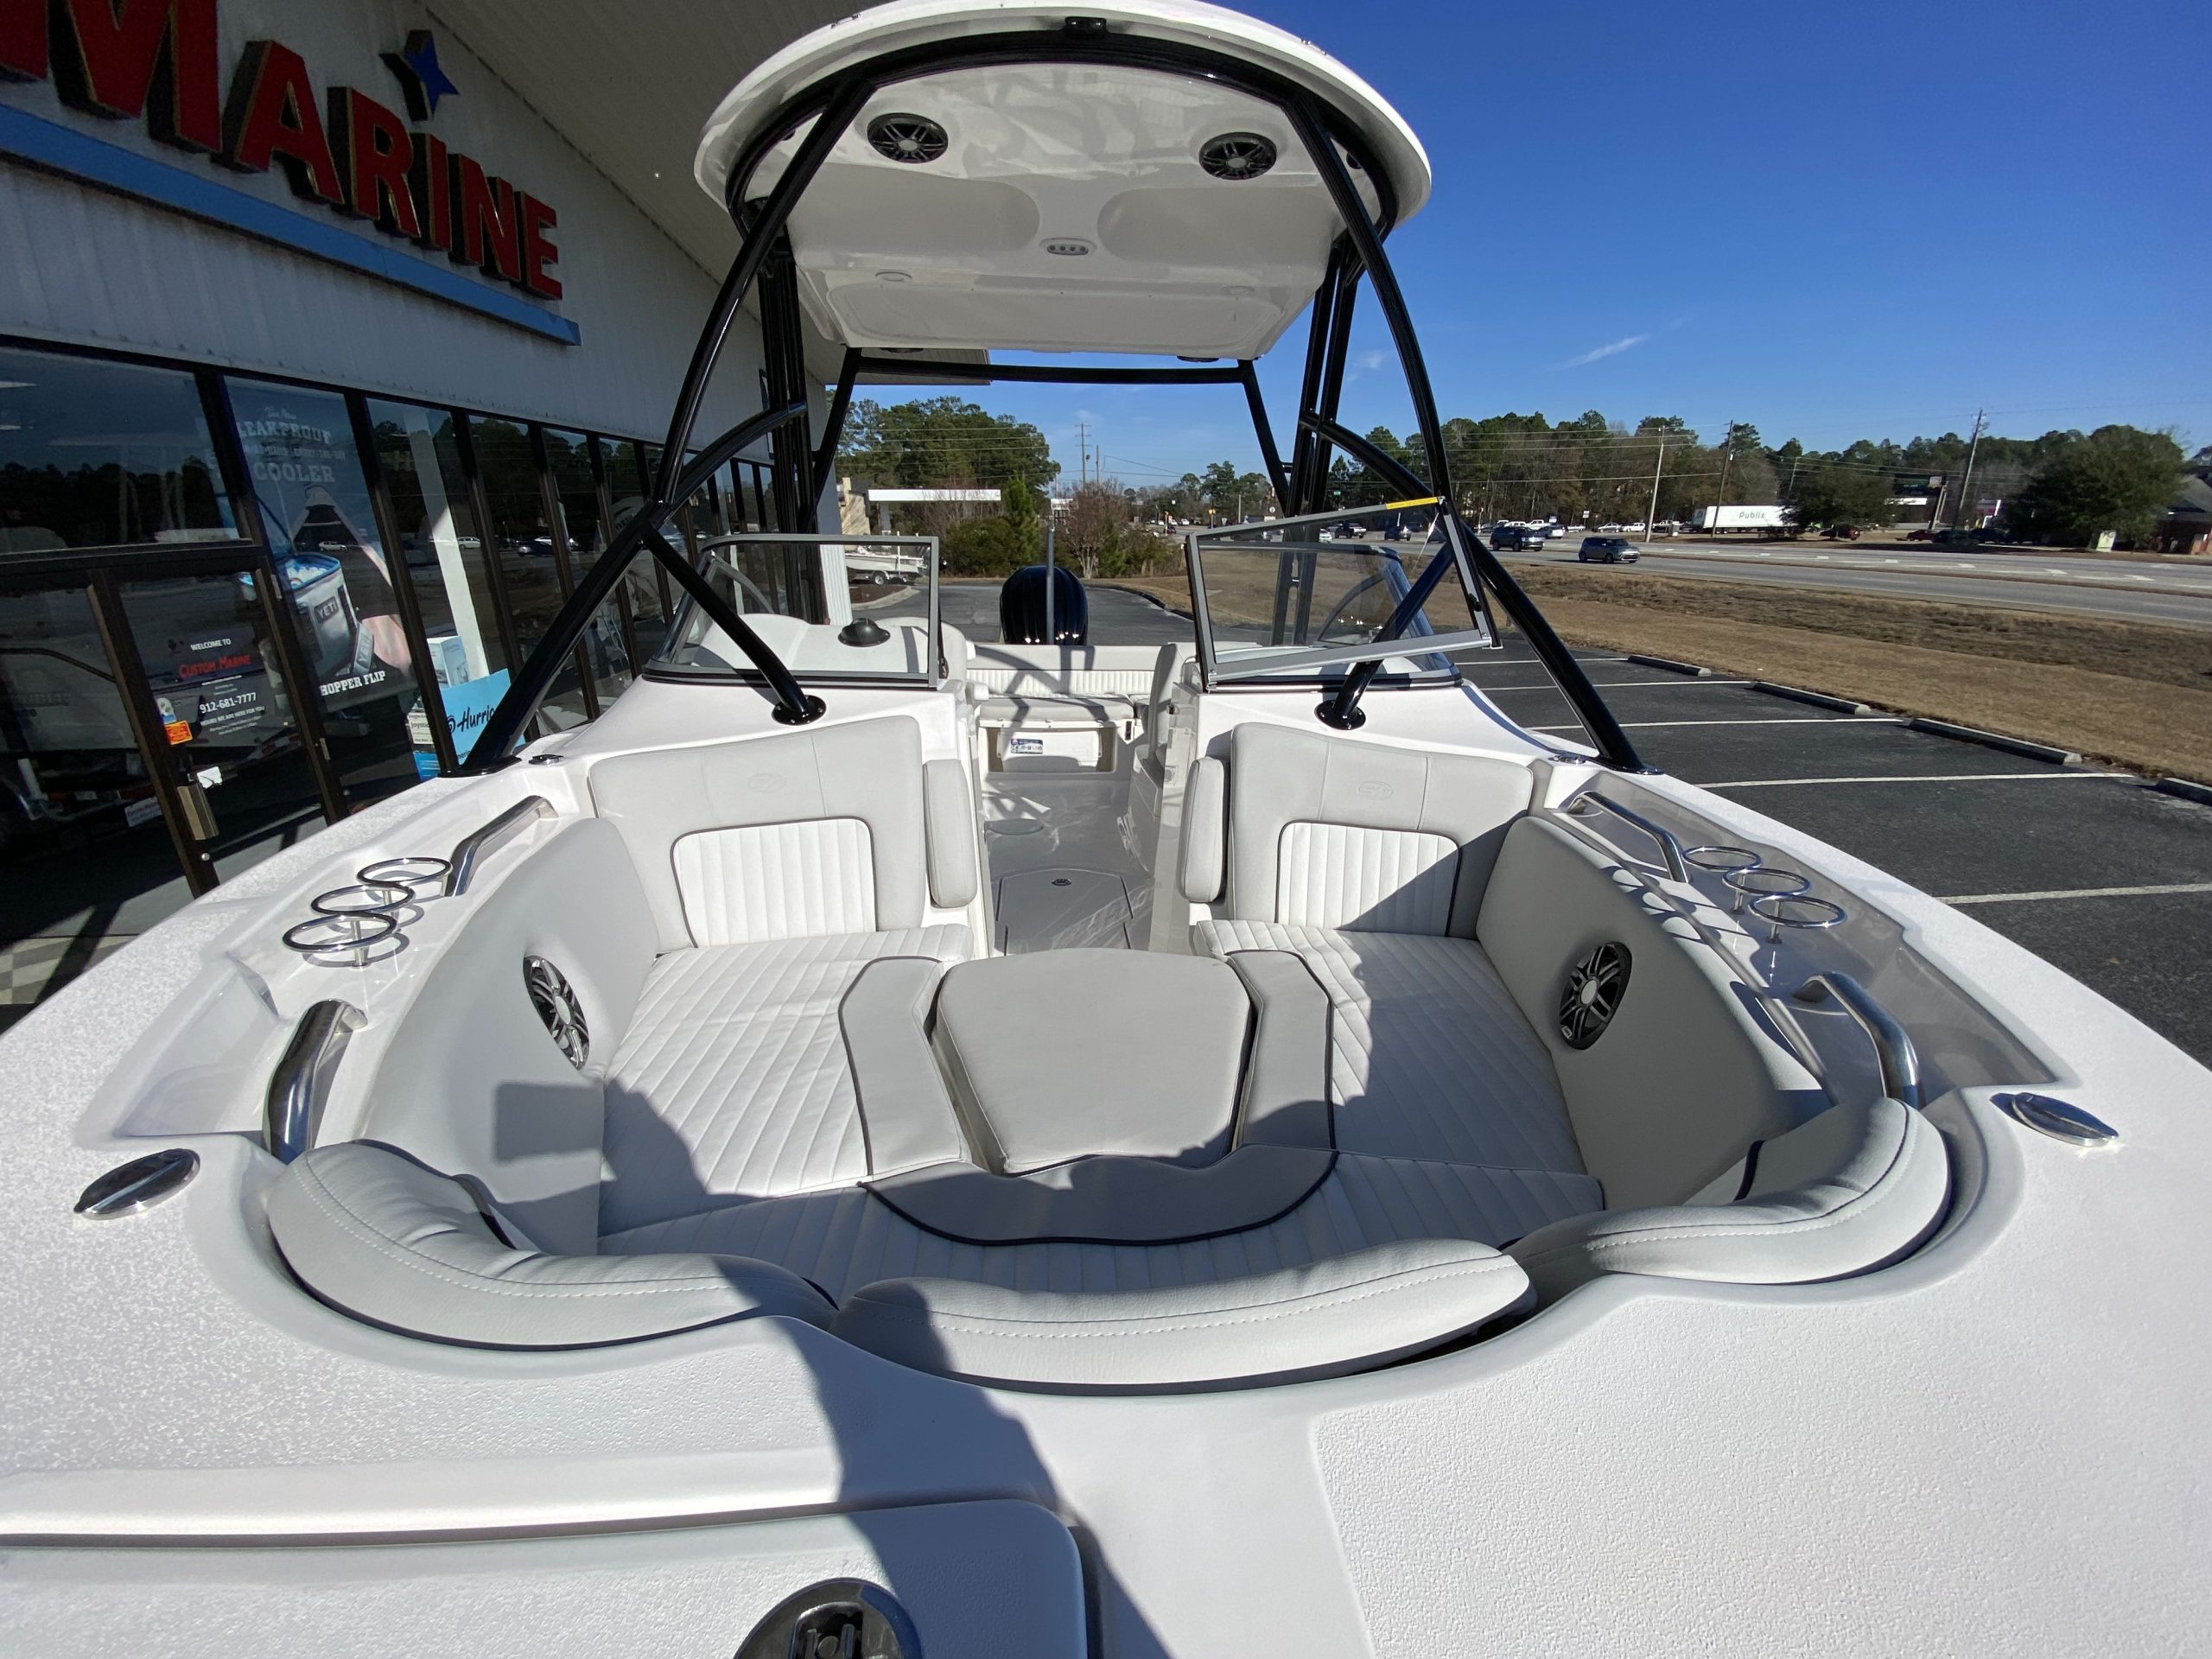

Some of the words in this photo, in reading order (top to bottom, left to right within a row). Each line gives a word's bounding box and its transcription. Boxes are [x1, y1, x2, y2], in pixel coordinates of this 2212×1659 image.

[0, 0, 563, 301] MARINE
[252, 461, 337, 483] COOLER
[1738, 511, 1765, 519] Publix
[316, 601, 338, 620] YETI
[190, 640, 222, 651] WELCOME
[319, 677, 364, 696] HOPPER
[363, 670, 386, 686] FLIP
[200, 692, 257, 713] 912-681-7777
